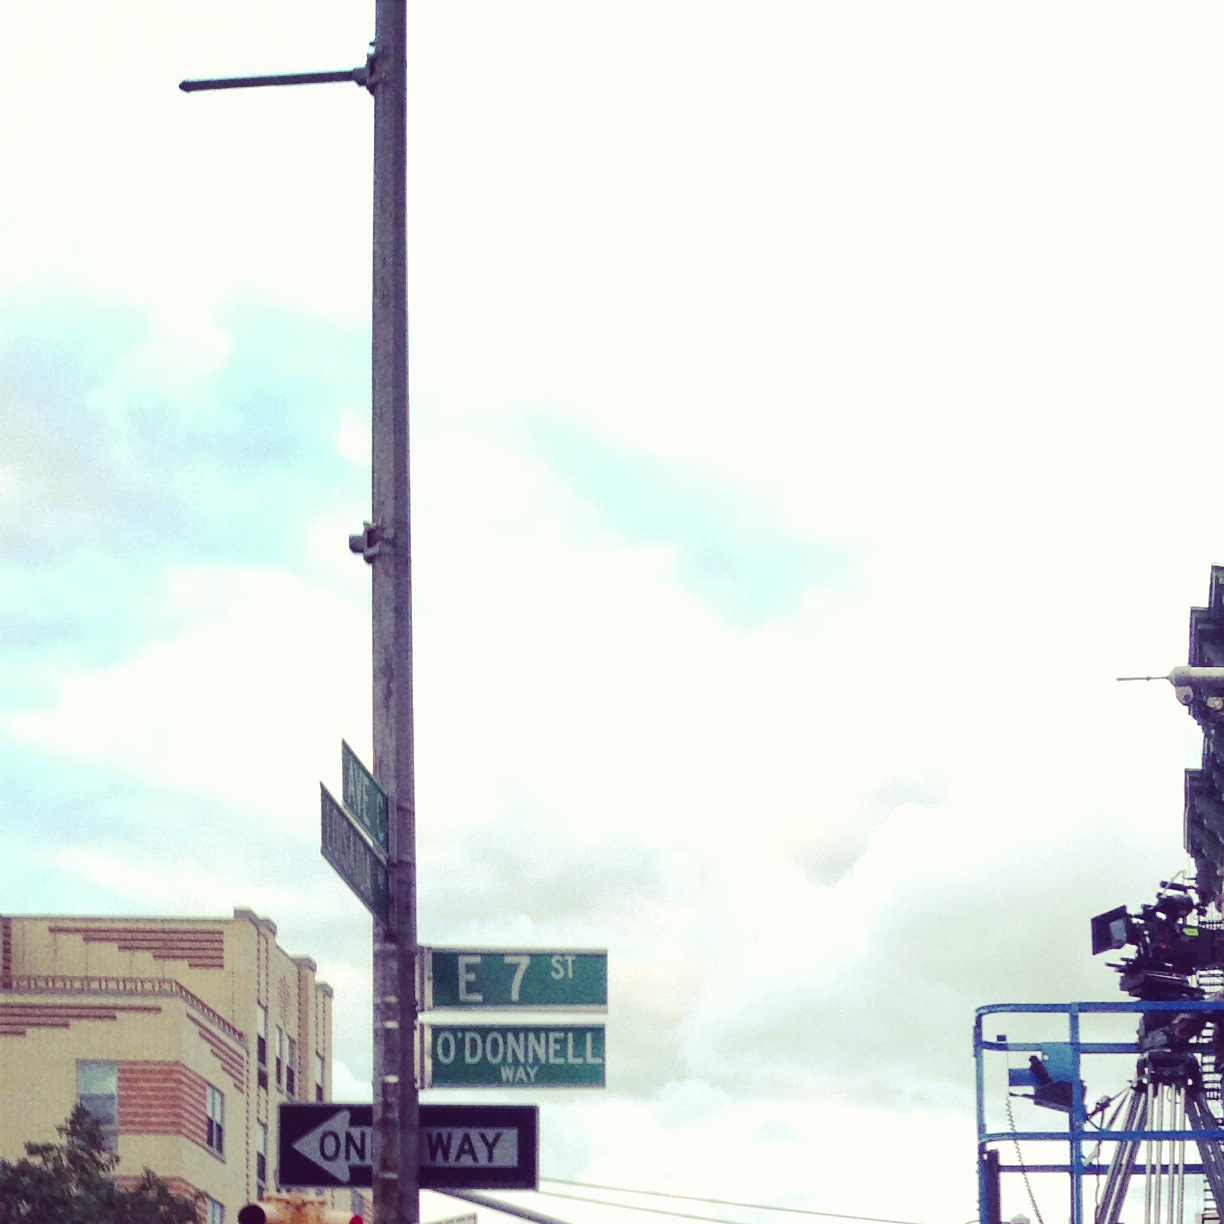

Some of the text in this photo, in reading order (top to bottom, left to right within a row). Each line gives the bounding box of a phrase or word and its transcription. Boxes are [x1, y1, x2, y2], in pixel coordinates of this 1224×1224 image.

[458, 955, 576, 1002] E 7 ST
[437, 1031, 602, 1065] O'DONNELL
[501, 1065, 538, 1083] WAY
[319, 1130, 502, 1163] ON WAY
